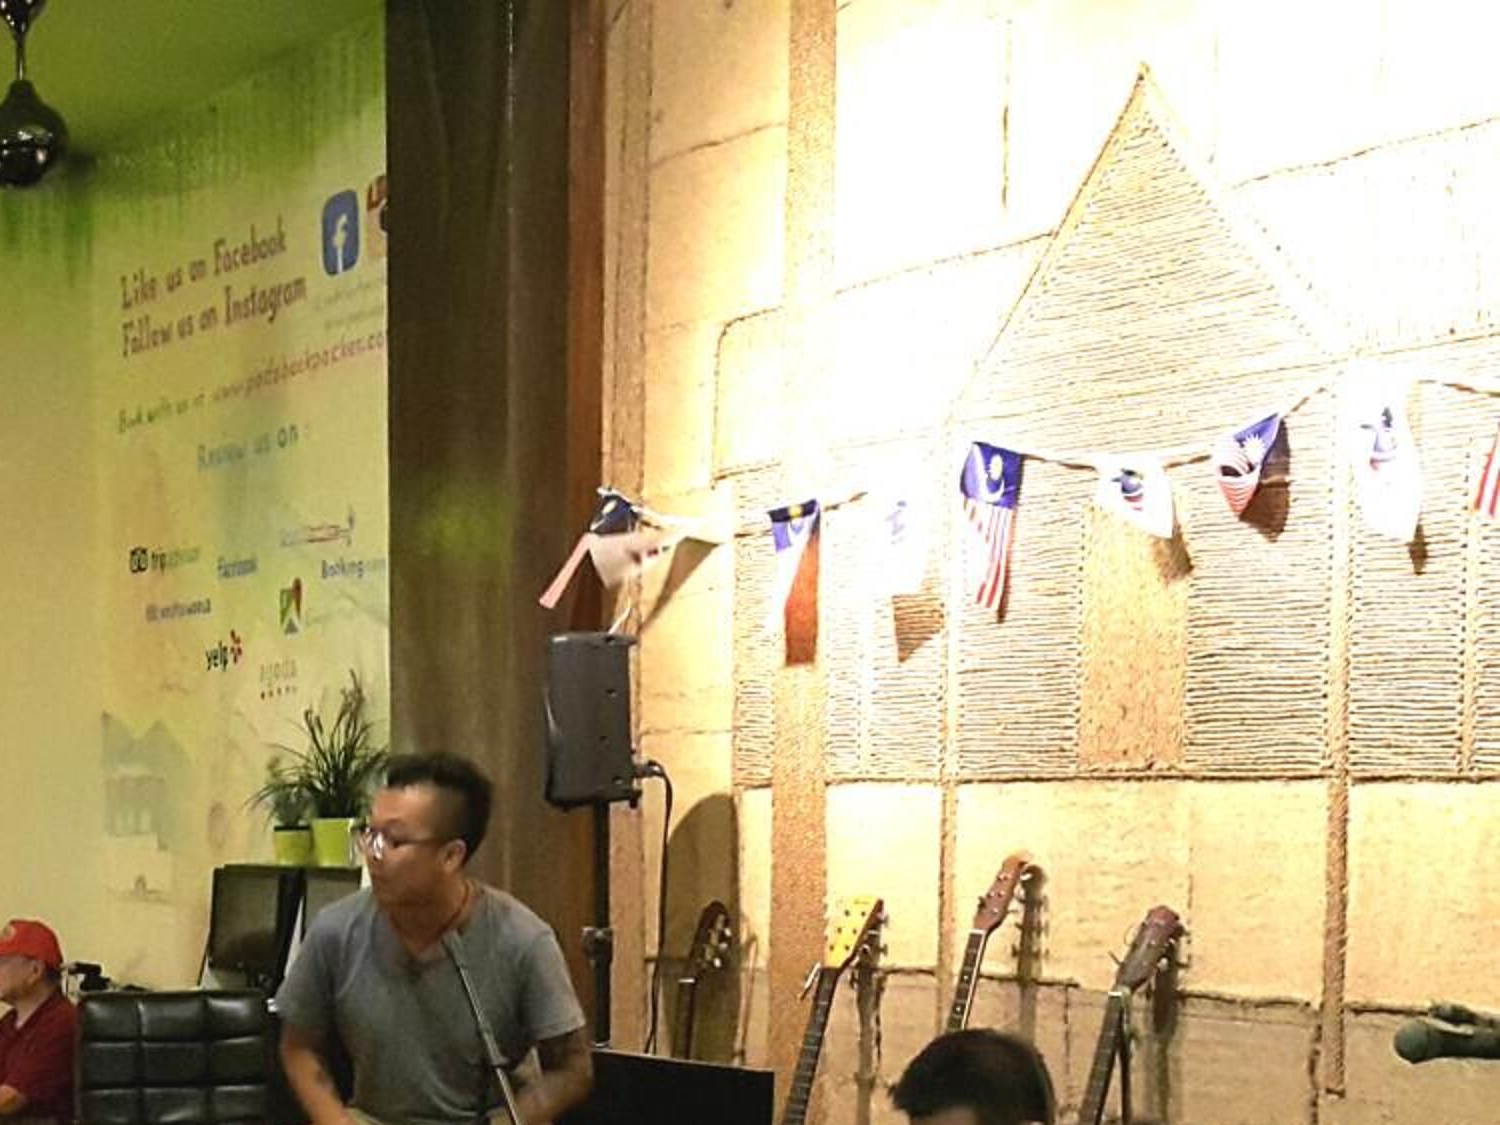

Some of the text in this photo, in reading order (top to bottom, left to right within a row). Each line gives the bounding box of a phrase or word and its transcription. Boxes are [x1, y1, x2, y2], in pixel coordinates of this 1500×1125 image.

[120, 213, 288, 311] Like us on Facebook
[122, 313, 175, 358] Follow
[177, 313, 194, 339] us
[200, 306, 219, 332] on
[224, 275, 308, 327] Instagram
[205, 639, 229, 673] yelp
